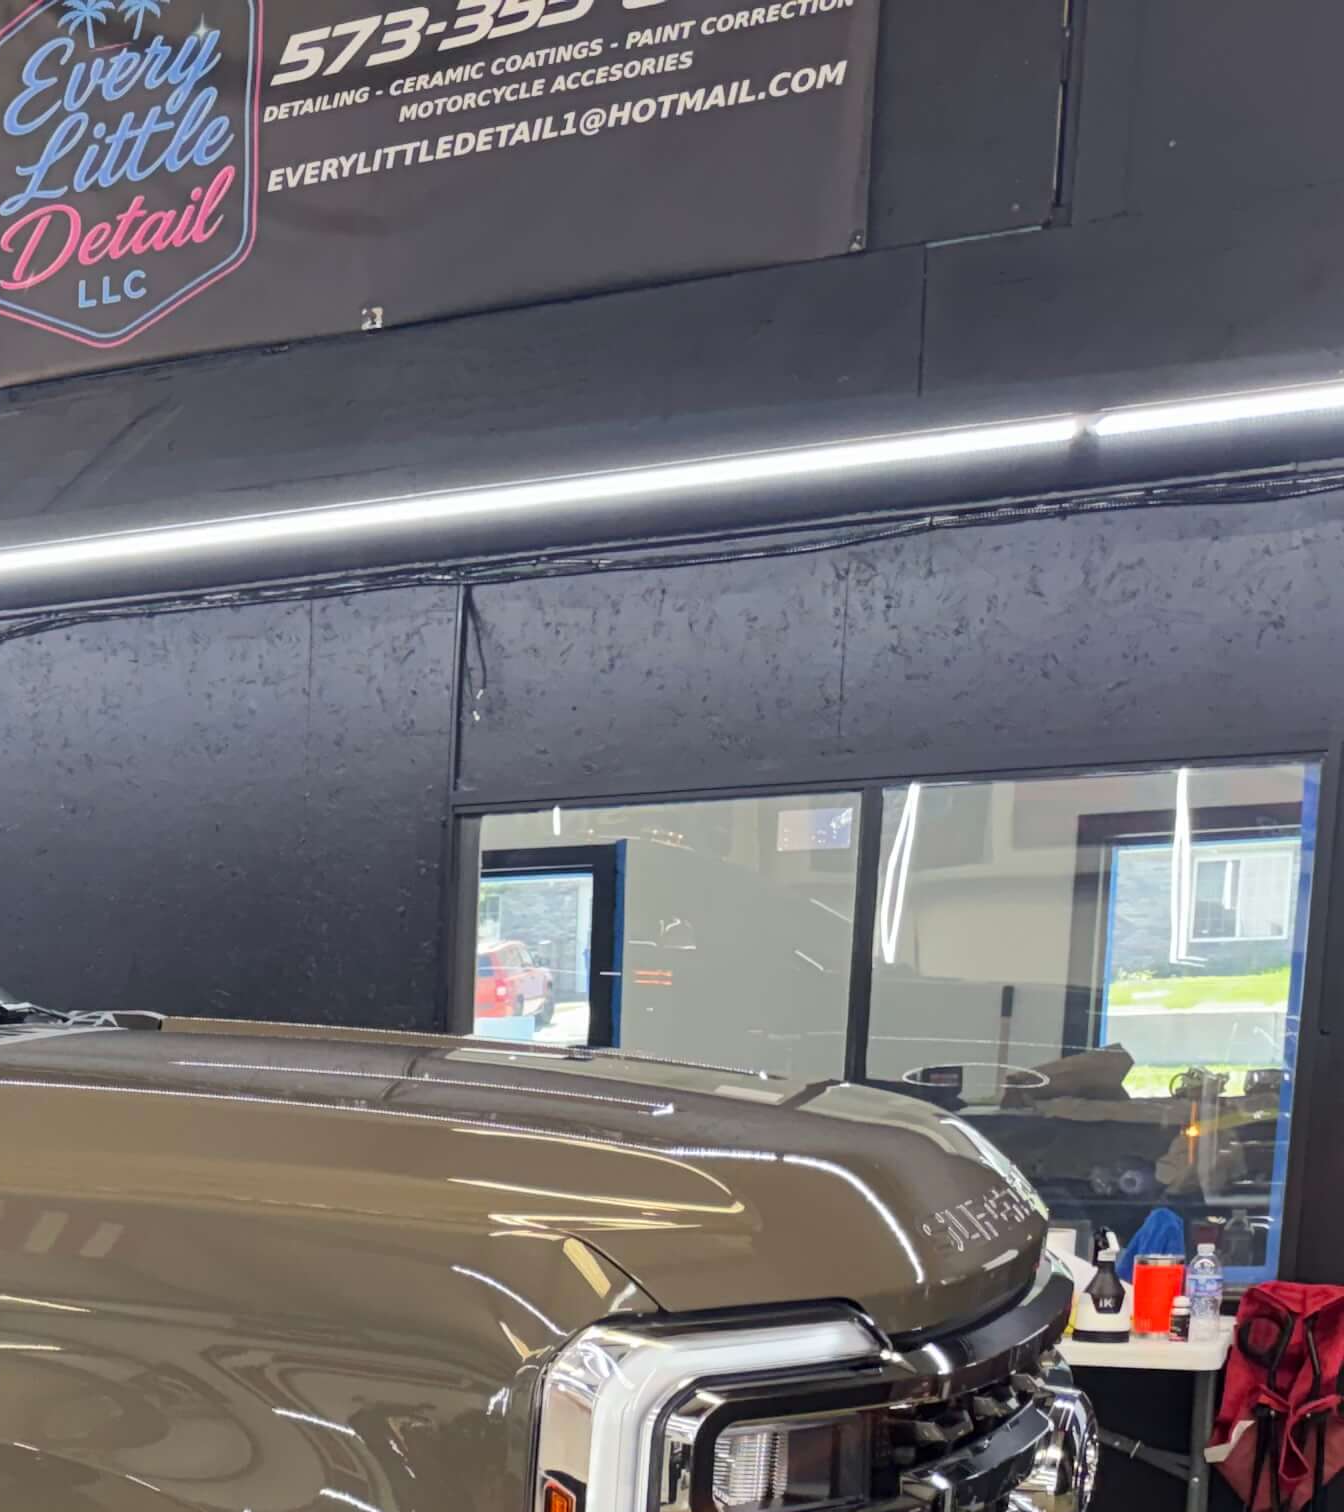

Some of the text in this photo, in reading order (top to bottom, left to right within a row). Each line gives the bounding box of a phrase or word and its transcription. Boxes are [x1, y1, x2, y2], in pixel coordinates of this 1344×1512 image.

[3, 29, 222, 136] Every
[263, 86, 371, 123] DETAILING
[389, 61, 486, 97] CERAMIC
[491, 38, 604, 76] COATINGS
[625, 20, 697, 50] PAINT
[398, 50, 694, 123] MOTORCYCLE ACCESORIES
[0, 86, 235, 217] Little
[267, 60, 848, 193] EVERYLITTLEDETAIL1@HOTMAIL.COM
[0, 165, 236, 290] Detail
[78, 269, 147, 309] LLC
